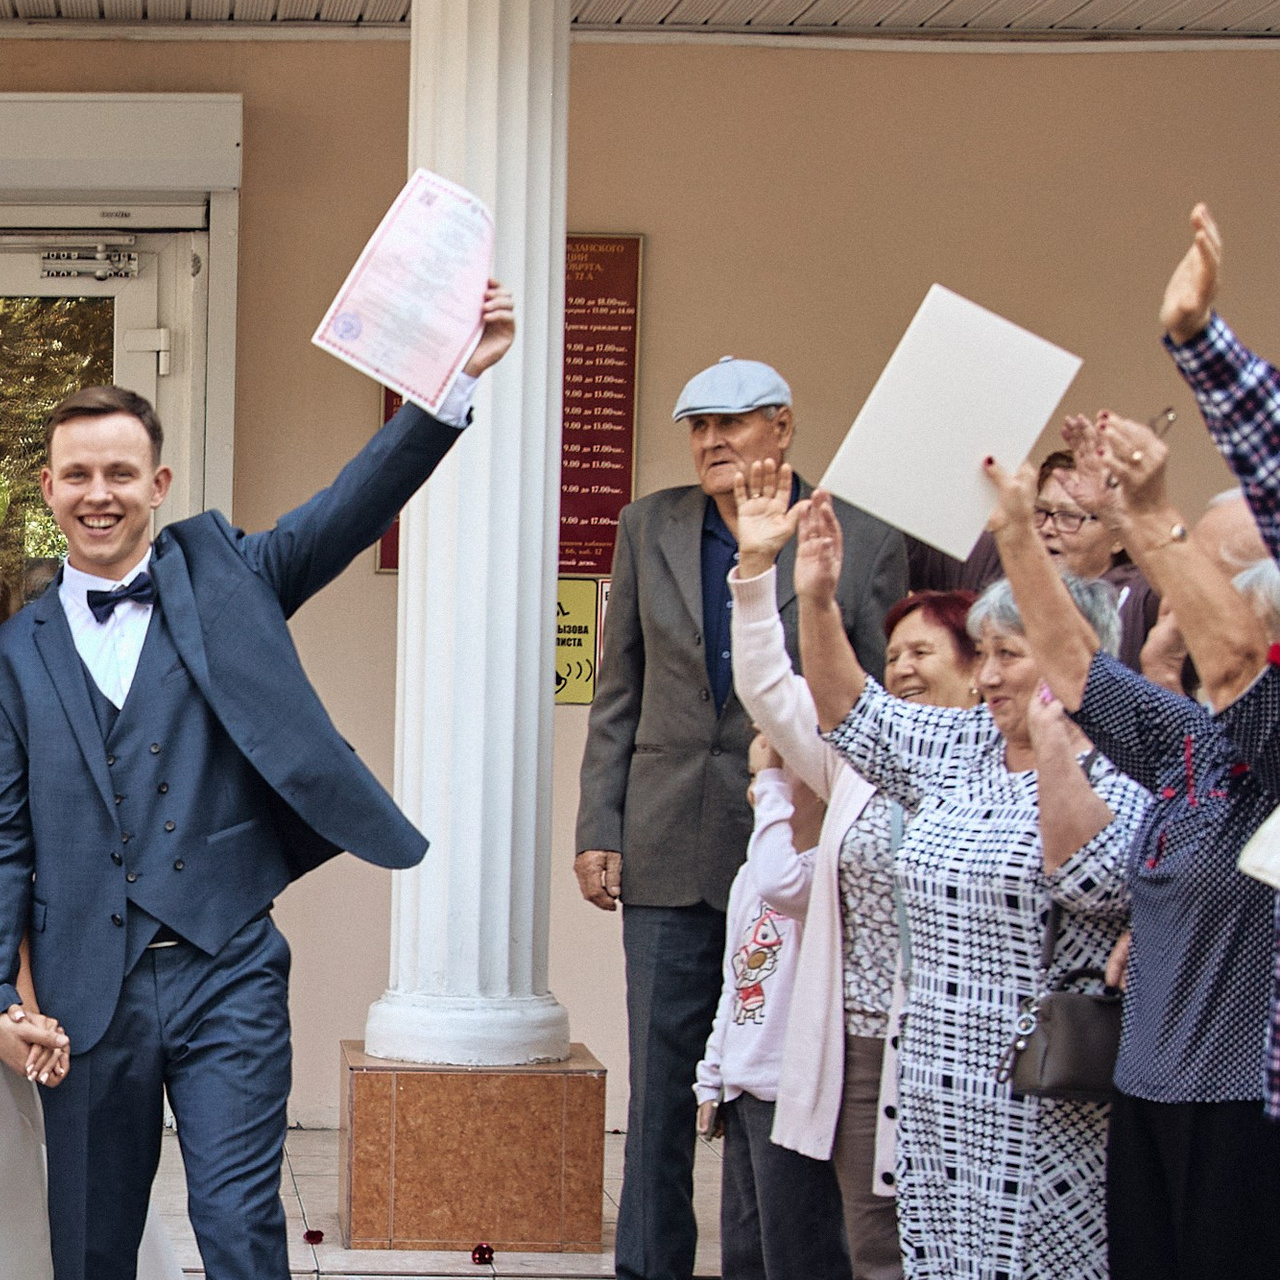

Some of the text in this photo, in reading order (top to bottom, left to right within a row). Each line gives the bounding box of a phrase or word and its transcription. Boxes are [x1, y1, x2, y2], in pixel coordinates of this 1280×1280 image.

[566, 344, 584, 352] 9.00
[566, 357, 583, 365] 9.00
[565, 375, 583, 383] 9.00
[563, 444, 580, 452] 9.00
[563, 460, 580, 468] 9.00
